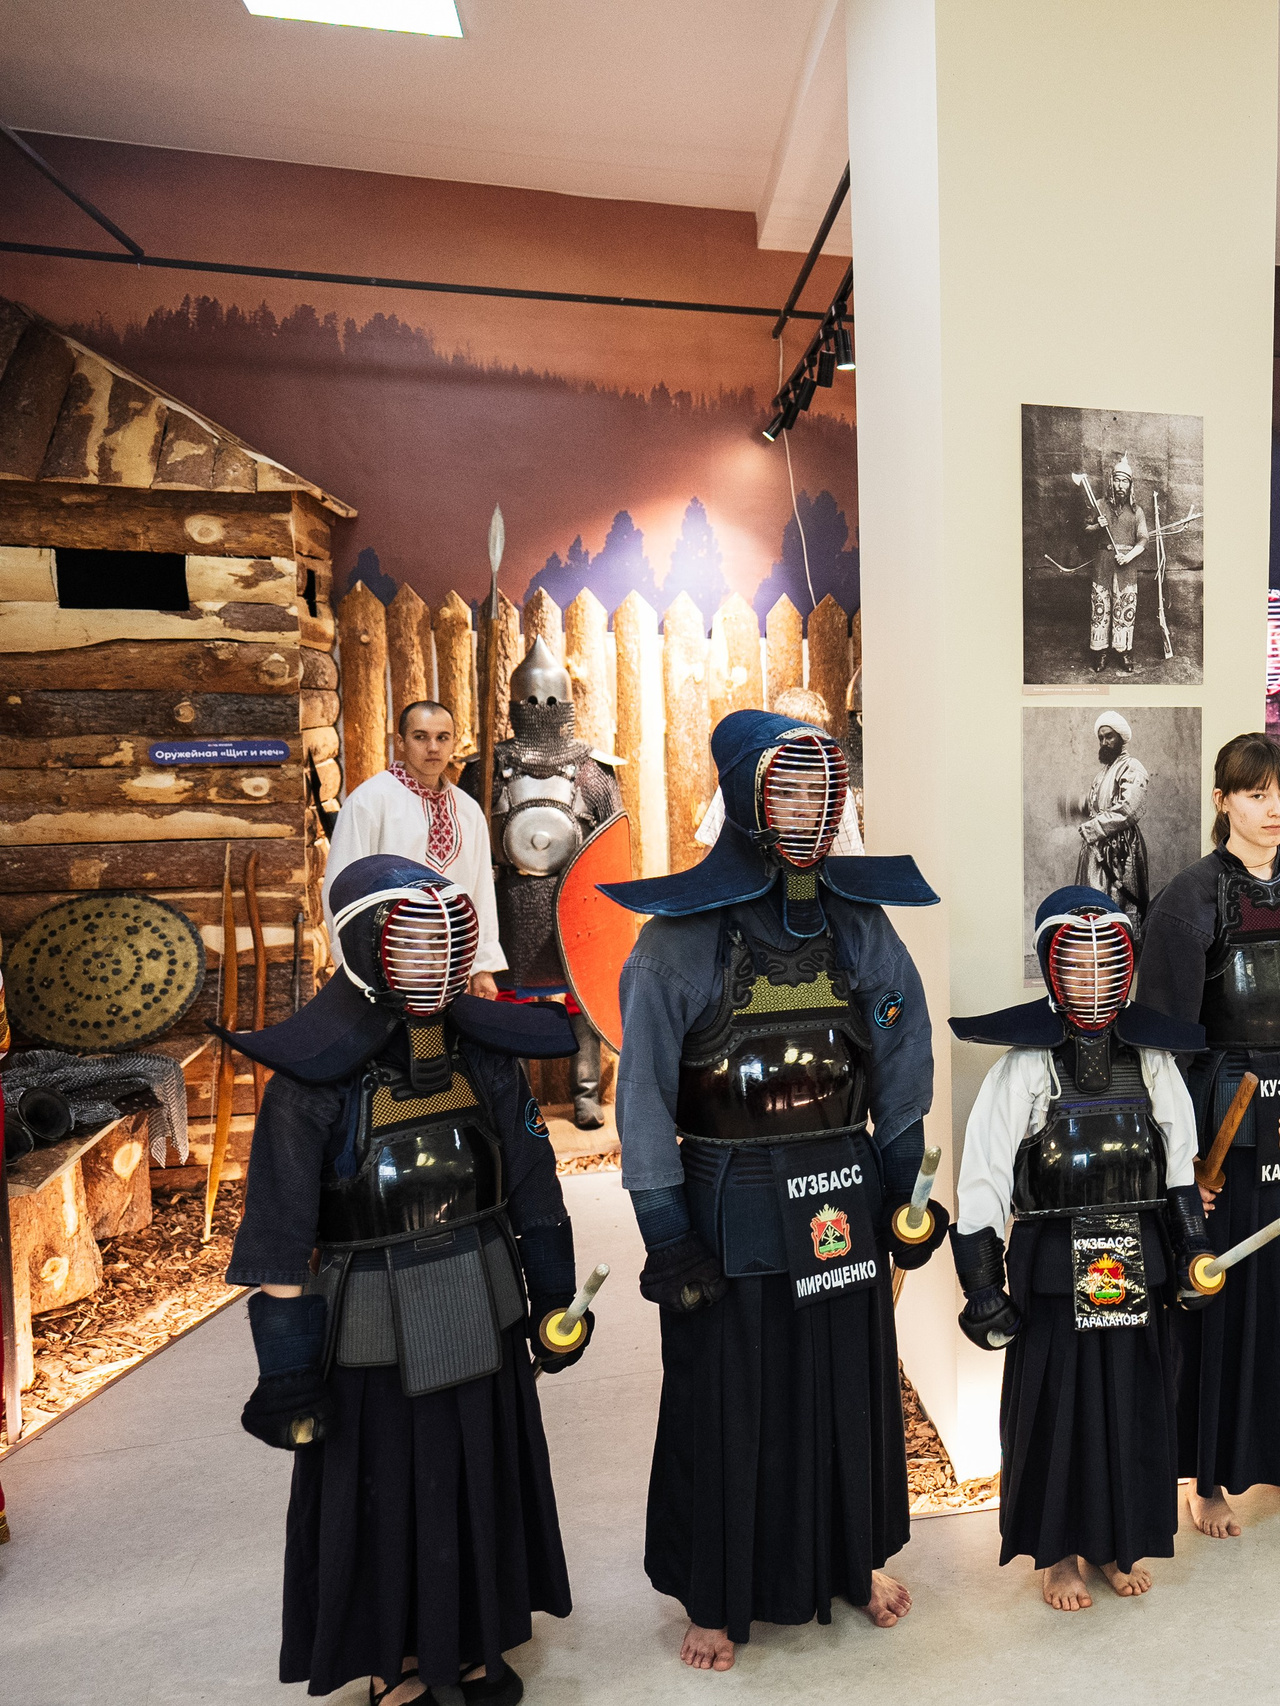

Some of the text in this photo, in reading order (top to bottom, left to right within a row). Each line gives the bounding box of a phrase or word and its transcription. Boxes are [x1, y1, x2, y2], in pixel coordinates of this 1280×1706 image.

[155, 749, 218, 760] Оружейная
[220, 749, 248, 758] «Щит
[787, 1164, 863, 1199] КУЗБАСС
[1073, 1236, 1133, 1250] КУЗБАСС
[796, 1259, 877, 1298] МИРОЩЕНКО
[1076, 1313, 1138, 1329] ТАРАКАНОВ
